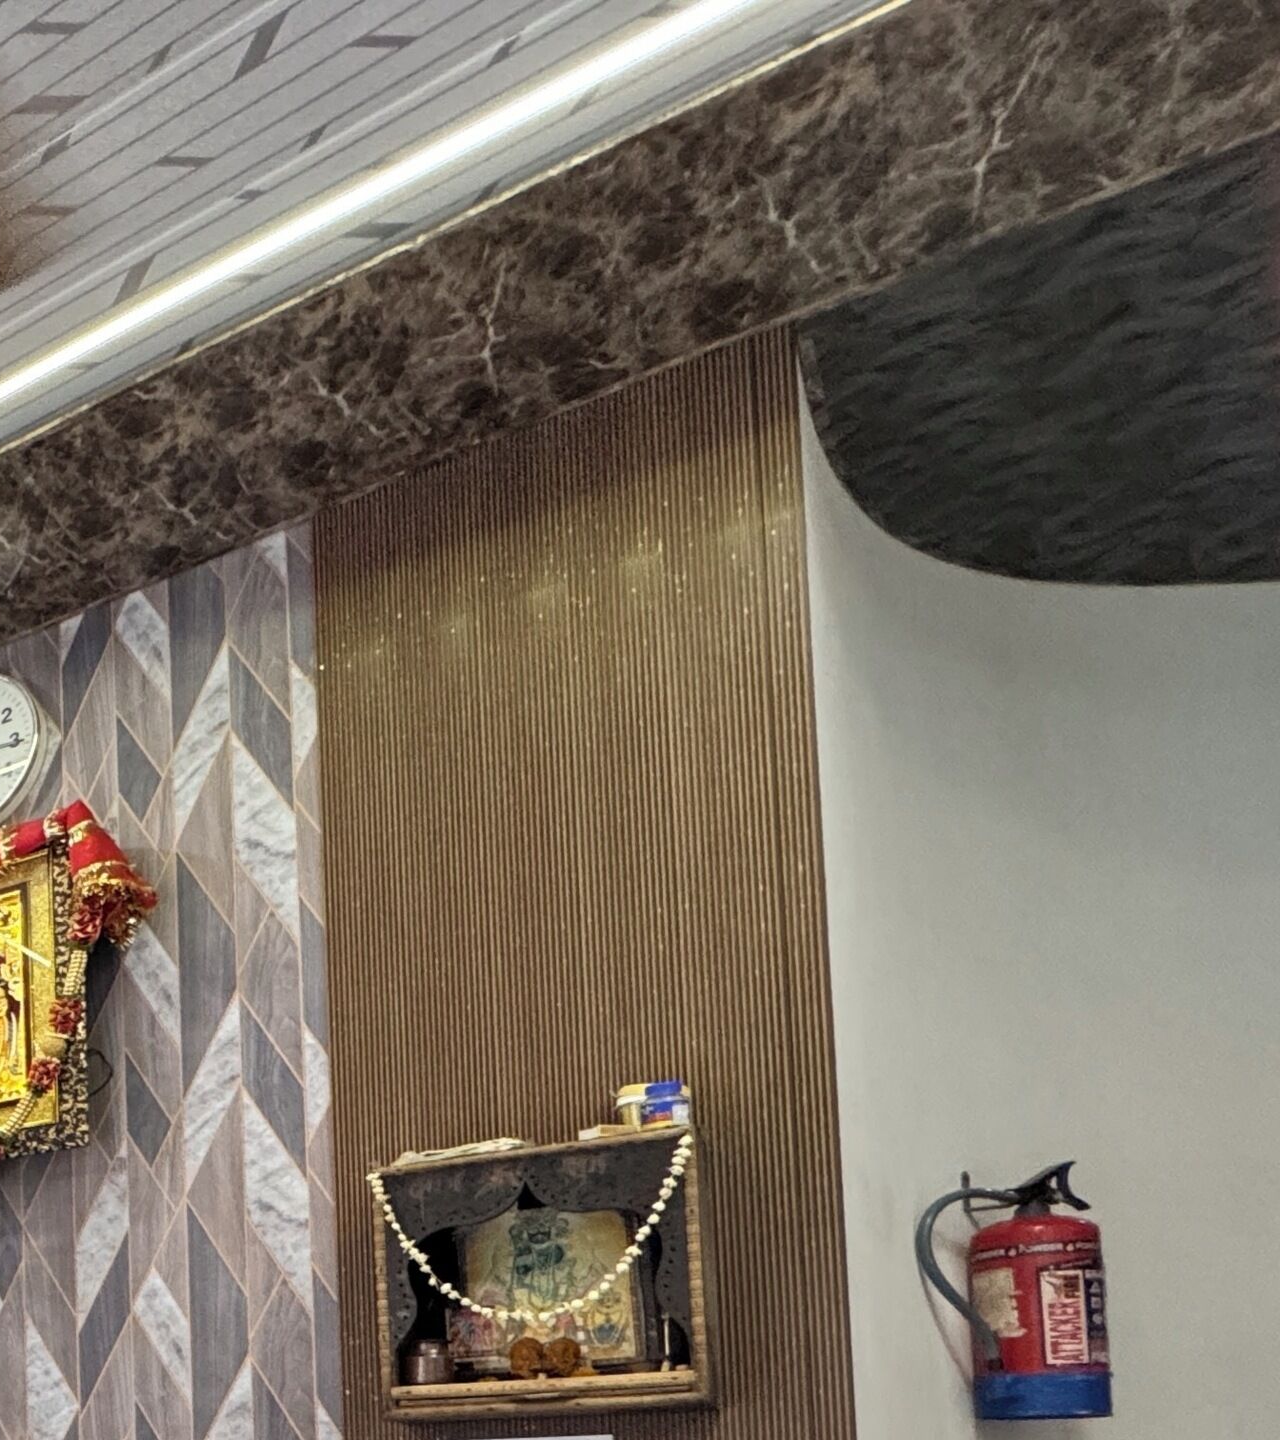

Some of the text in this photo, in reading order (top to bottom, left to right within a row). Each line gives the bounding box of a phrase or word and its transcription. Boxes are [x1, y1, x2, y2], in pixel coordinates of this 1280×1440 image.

[1, 707, 12, 724] 2
[9, 732, 20, 747] 3
[1048, 1303, 1084, 1360] ATTACKER
